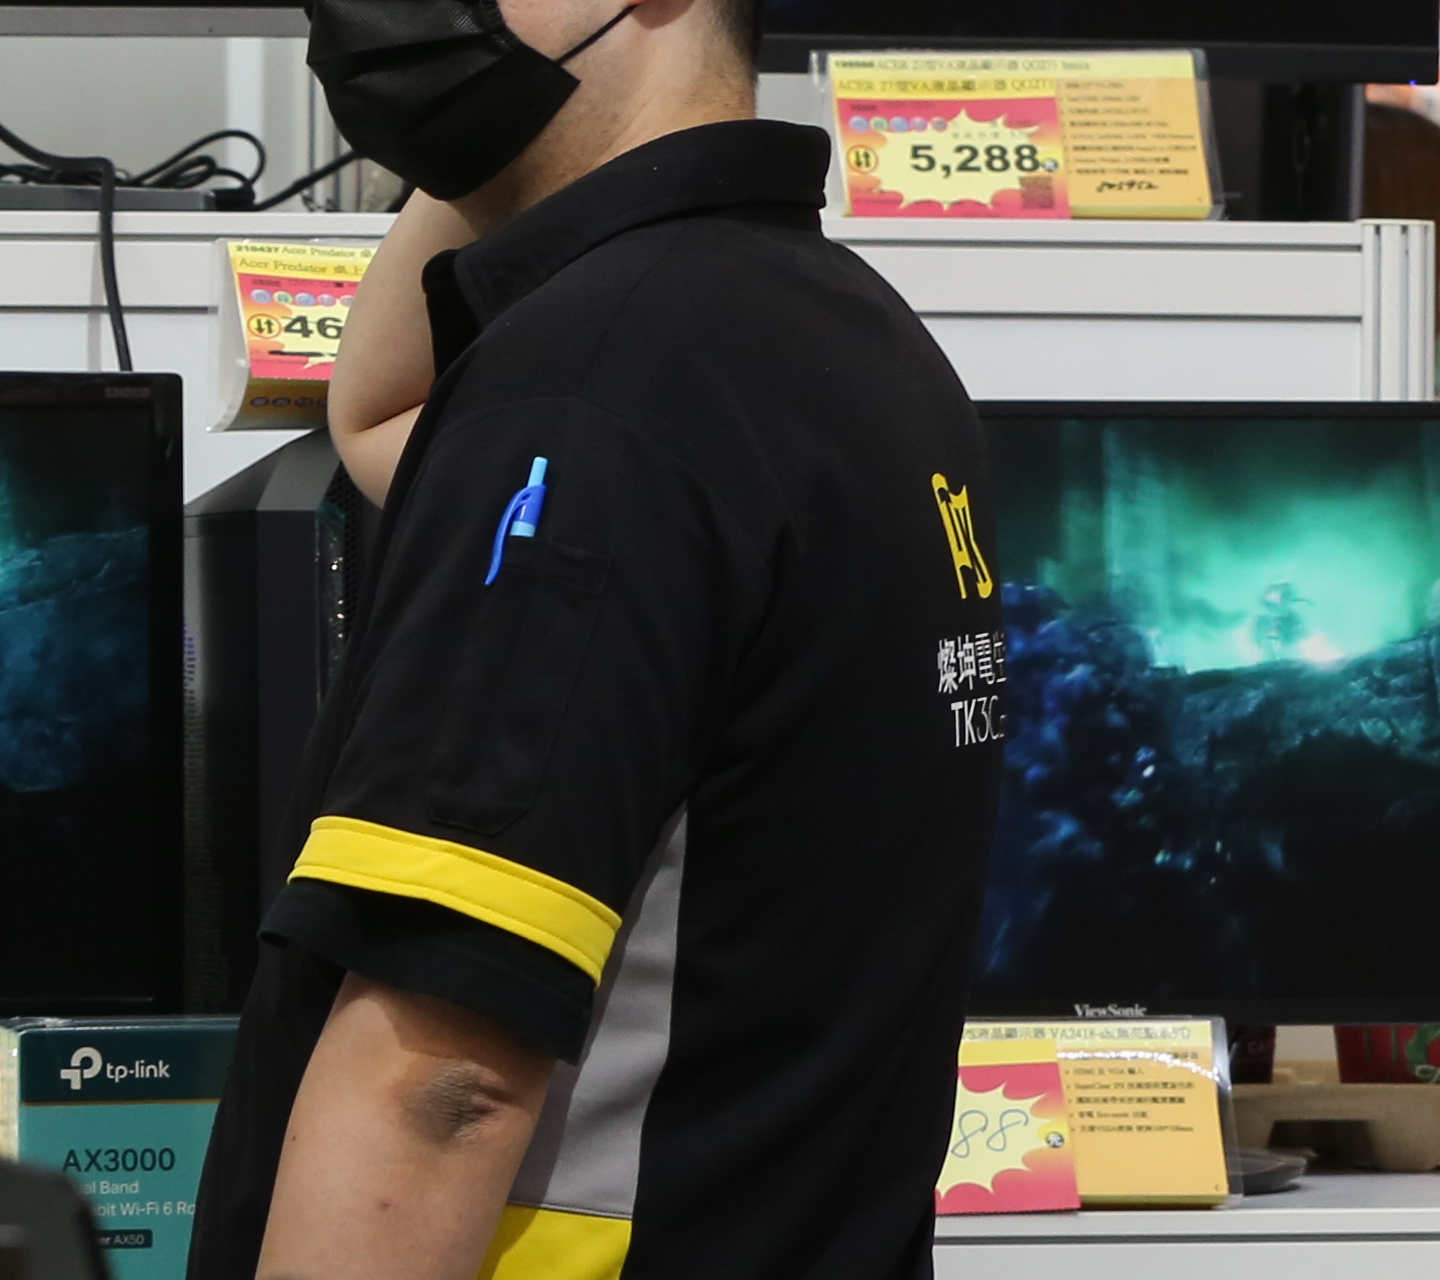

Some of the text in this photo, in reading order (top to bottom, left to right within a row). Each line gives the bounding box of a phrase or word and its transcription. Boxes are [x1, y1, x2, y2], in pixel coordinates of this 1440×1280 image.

[910, 143, 1040, 179] 5,288
[281, 244, 356, 259] Acer Predator
[238, 257, 328, 274] Acer Predator
[1073, 1003, 1148, 1017] ViewSonic
[106, 1059, 171, 1084] tp-link
[62, 1147, 176, 1173] AX3000
[99, 1180, 140, 1195] Band
[120, 1201, 173, 1216] Wi-Fi 6
[112, 1233, 145, 1245] AX50
